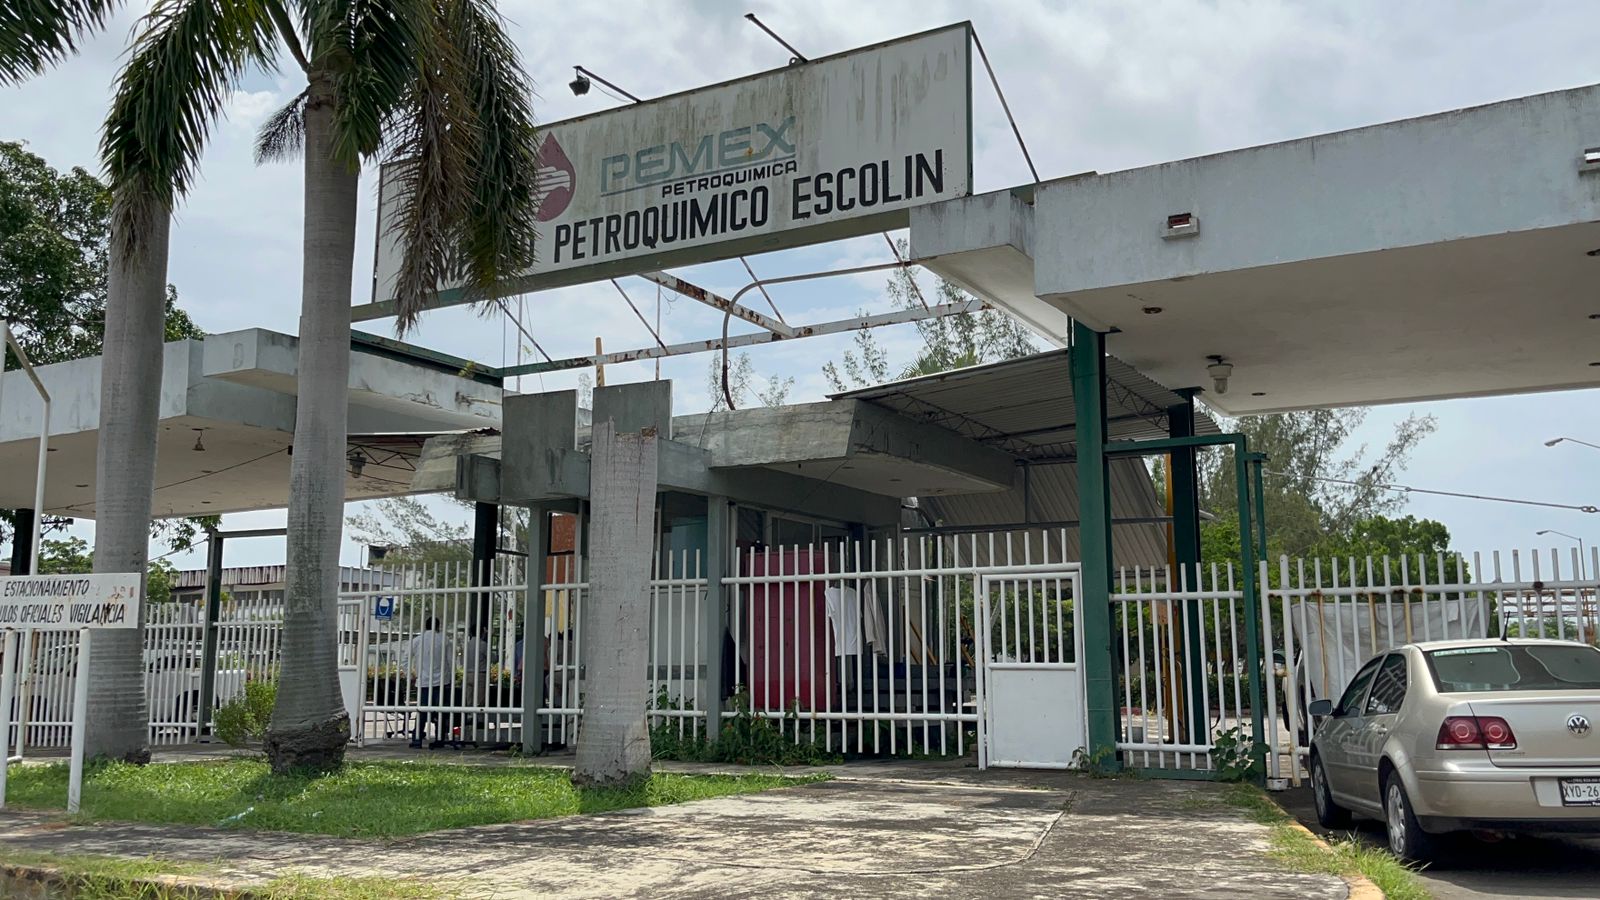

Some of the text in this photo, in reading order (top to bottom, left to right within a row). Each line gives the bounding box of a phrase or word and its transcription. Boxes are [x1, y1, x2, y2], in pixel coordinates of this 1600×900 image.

[600, 115, 797, 193] PEMEX
[662, 159, 797, 199] PETROQUIMICA
[553, 185, 769, 264] PETROQUIMICO
[791, 148, 944, 221] ESCOLIN
[4, 579, 90, 597] ESTACIONAMIENTO
[20, 604, 64, 623] OFICIALES
[69, 602, 125, 626] VIGILANCIA
